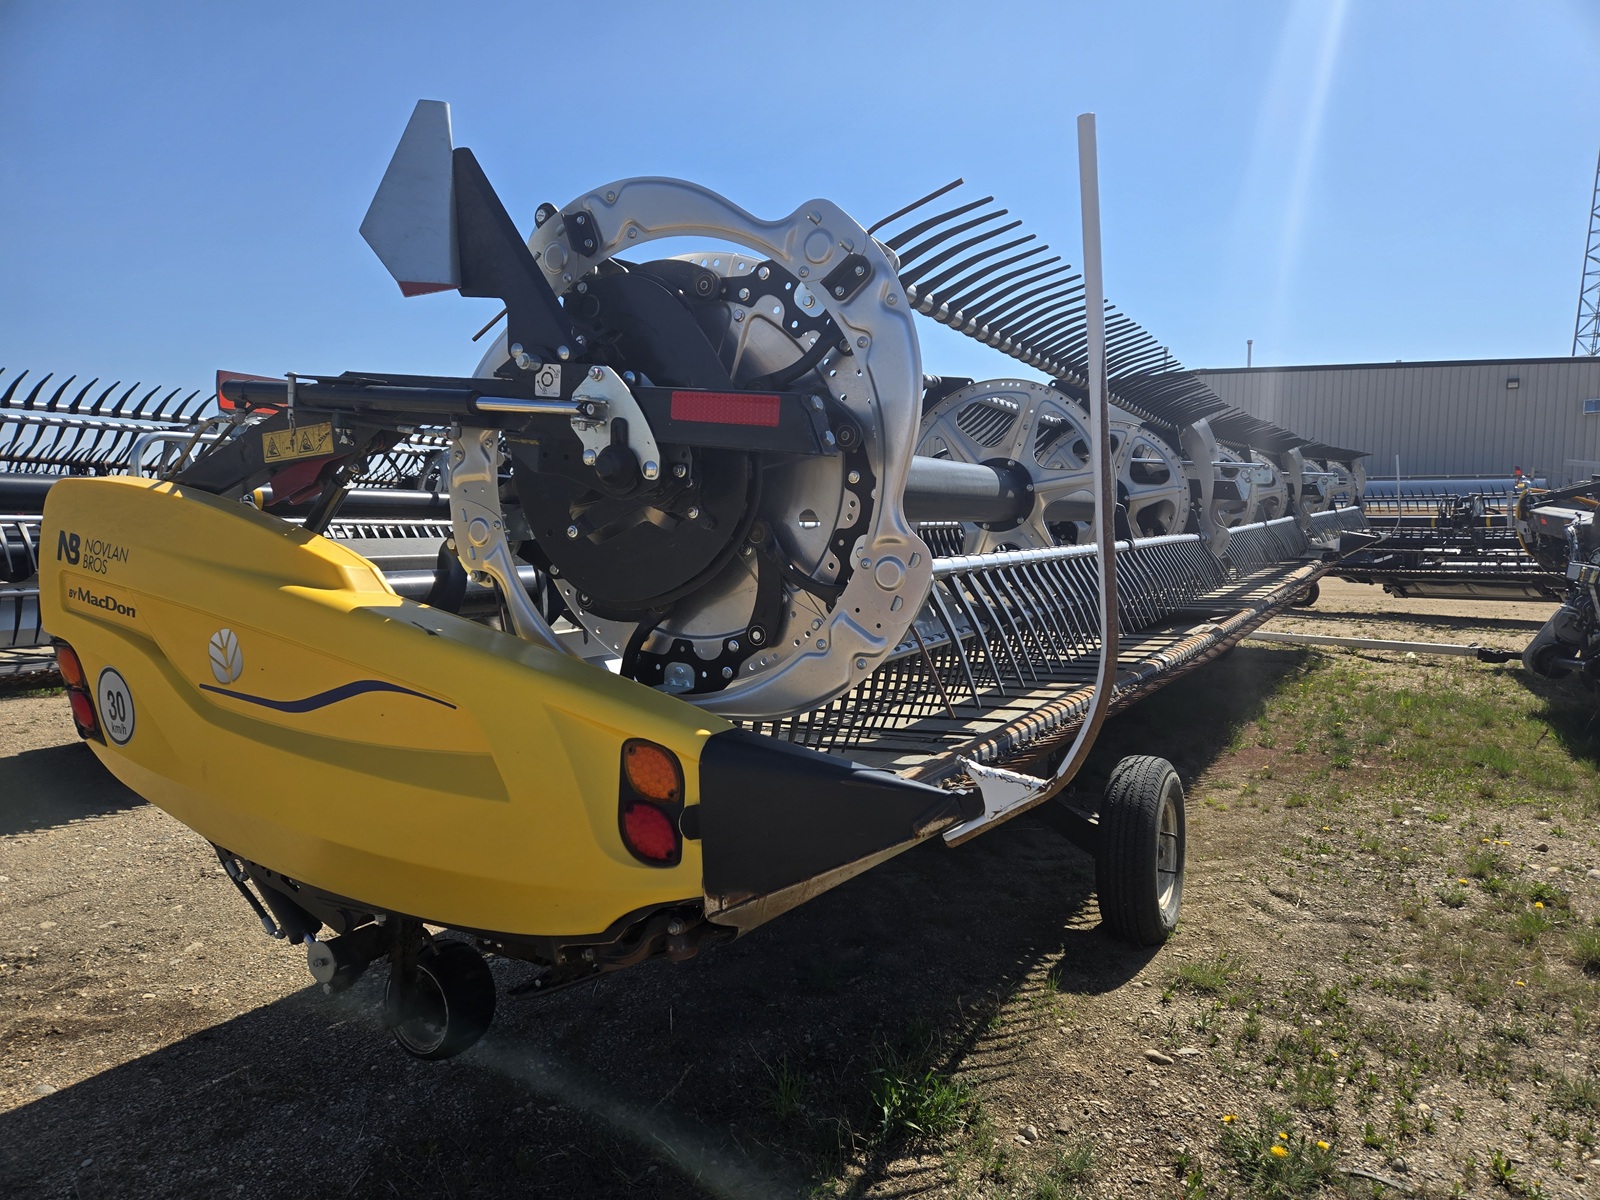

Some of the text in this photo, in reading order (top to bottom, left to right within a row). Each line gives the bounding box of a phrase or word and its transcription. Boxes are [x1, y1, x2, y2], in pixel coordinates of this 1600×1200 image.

[57, 529, 81, 565] NB
[84, 538, 129, 563] NOVLAN
[82, 557, 107, 575] BROS
[68, 587, 136, 618] BY MacDon
[107, 690, 125, 723] 30
[111, 722, 127, 736] km/h
